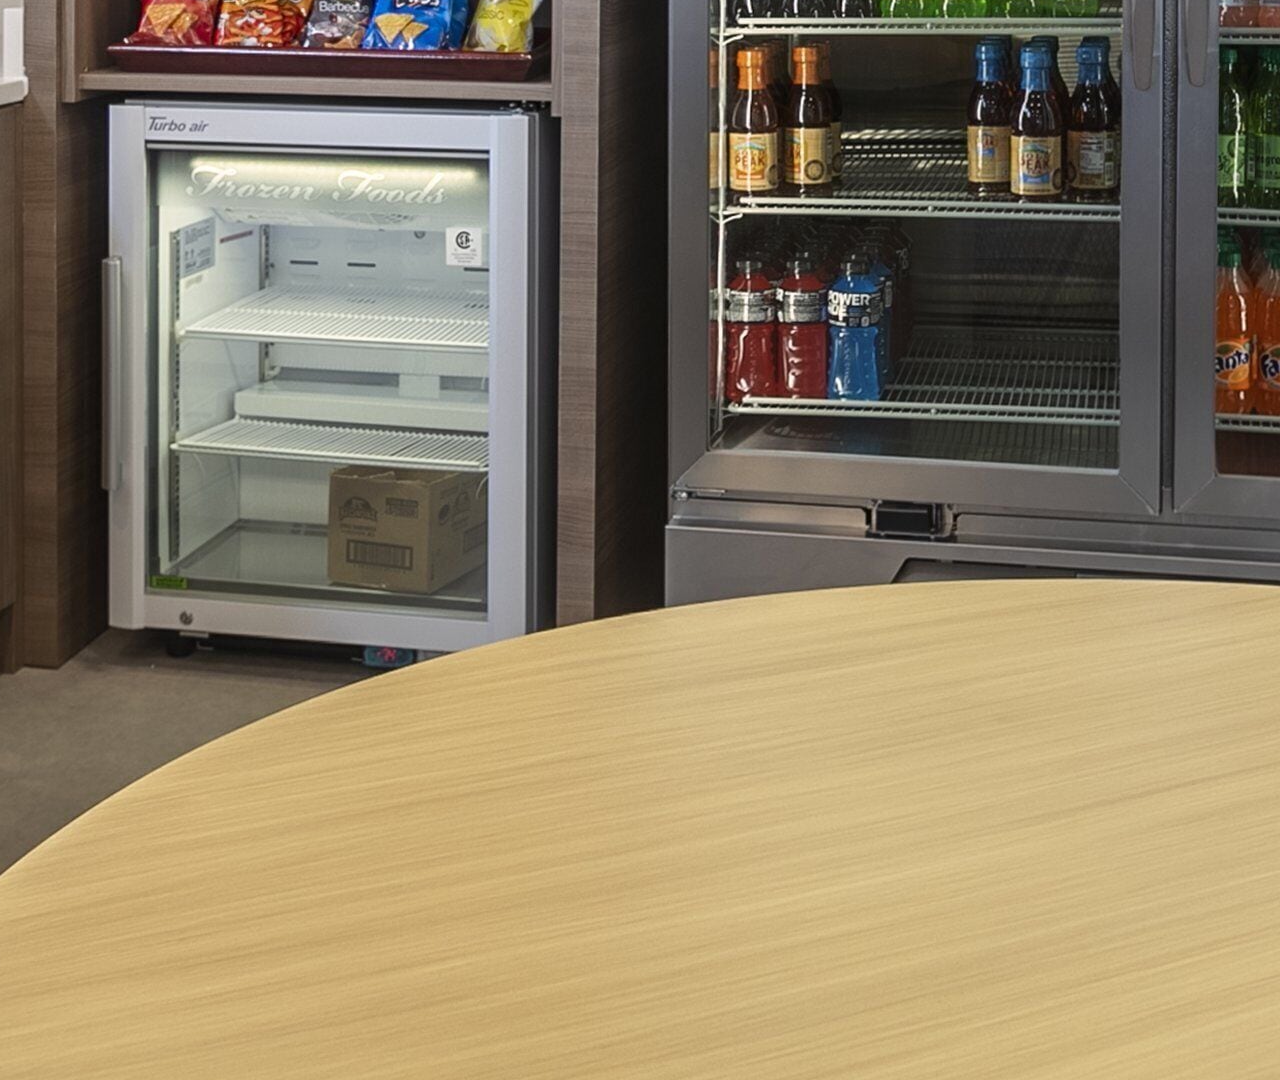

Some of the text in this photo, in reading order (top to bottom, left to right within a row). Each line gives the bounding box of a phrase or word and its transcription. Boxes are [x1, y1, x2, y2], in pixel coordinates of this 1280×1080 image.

[148, 115, 209, 133] Turbo air
[185, 165, 449, 205] Frozen Foods
[827, 290, 871, 306] POWER
